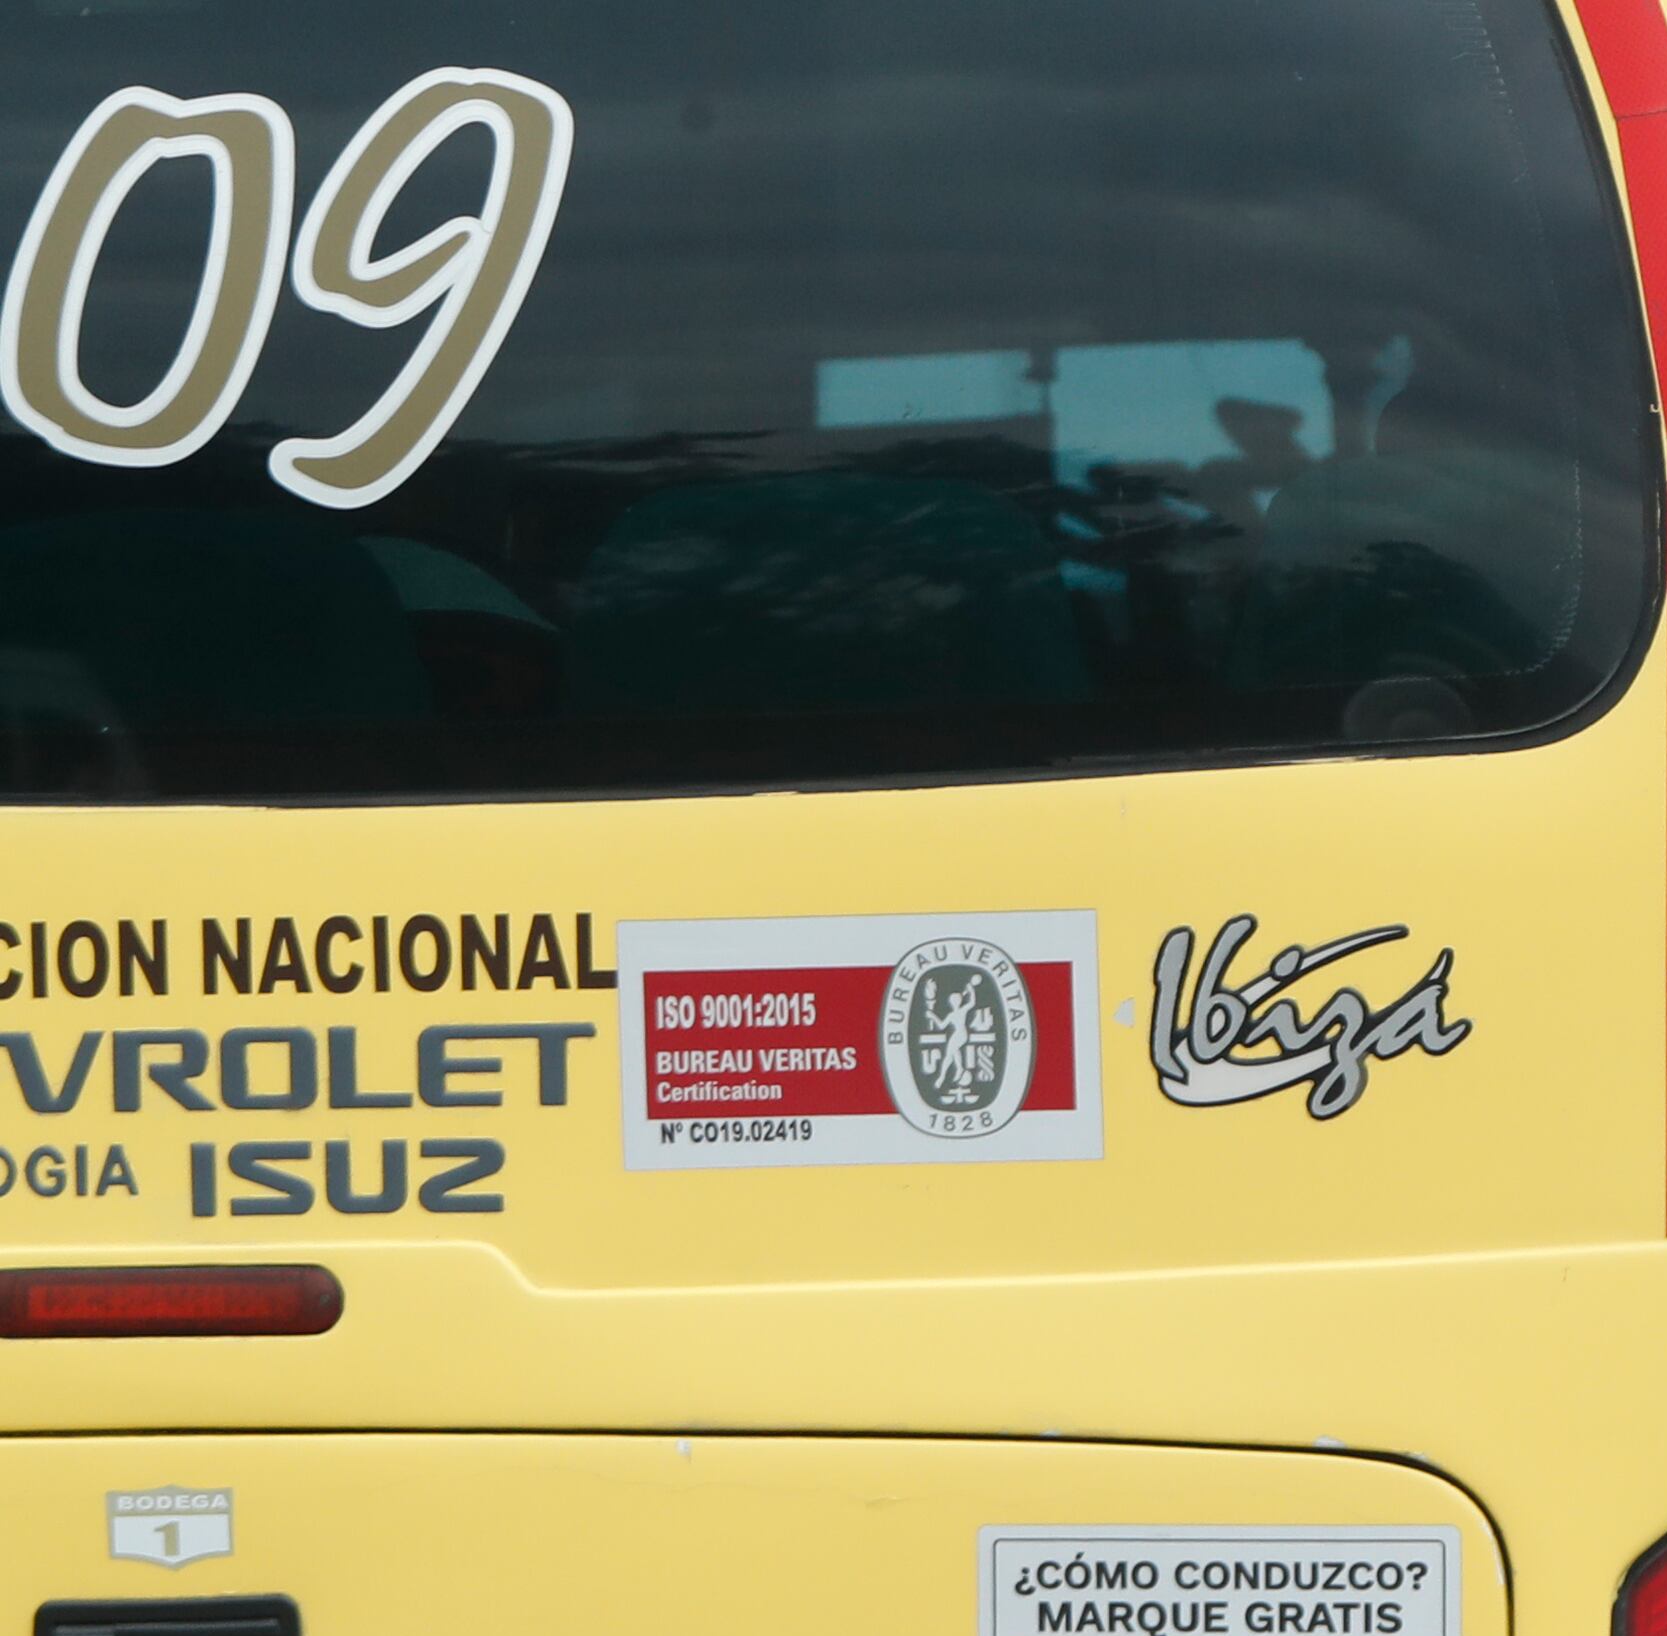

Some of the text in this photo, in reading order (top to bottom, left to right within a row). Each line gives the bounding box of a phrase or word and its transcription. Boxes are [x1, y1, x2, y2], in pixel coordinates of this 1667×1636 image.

[0, 66, 574, 510] 09
[202, 912, 618, 995] NACIONAL
[656, 991, 817, 1030] ISO 9001:2015
[887, 943, 1028, 1045] BUREAU VERITAS
[656, 1046, 858, 1076] BUREAU VERITAS
[656, 1078, 783, 1104] Certification
[689, 1118, 814, 1144] CO19.02419
[928, 1110, 995, 1133] 1828
[190, 1137, 506, 1217] ISUZ
[116, 1493, 229, 1512] BODEGA
[154, 1521, 181, 1557] 1
[1014, 1553, 1429, 1596] ¿CÓMO CONDUZCO?
[1244, 1601, 1403, 1634] GRATIS
